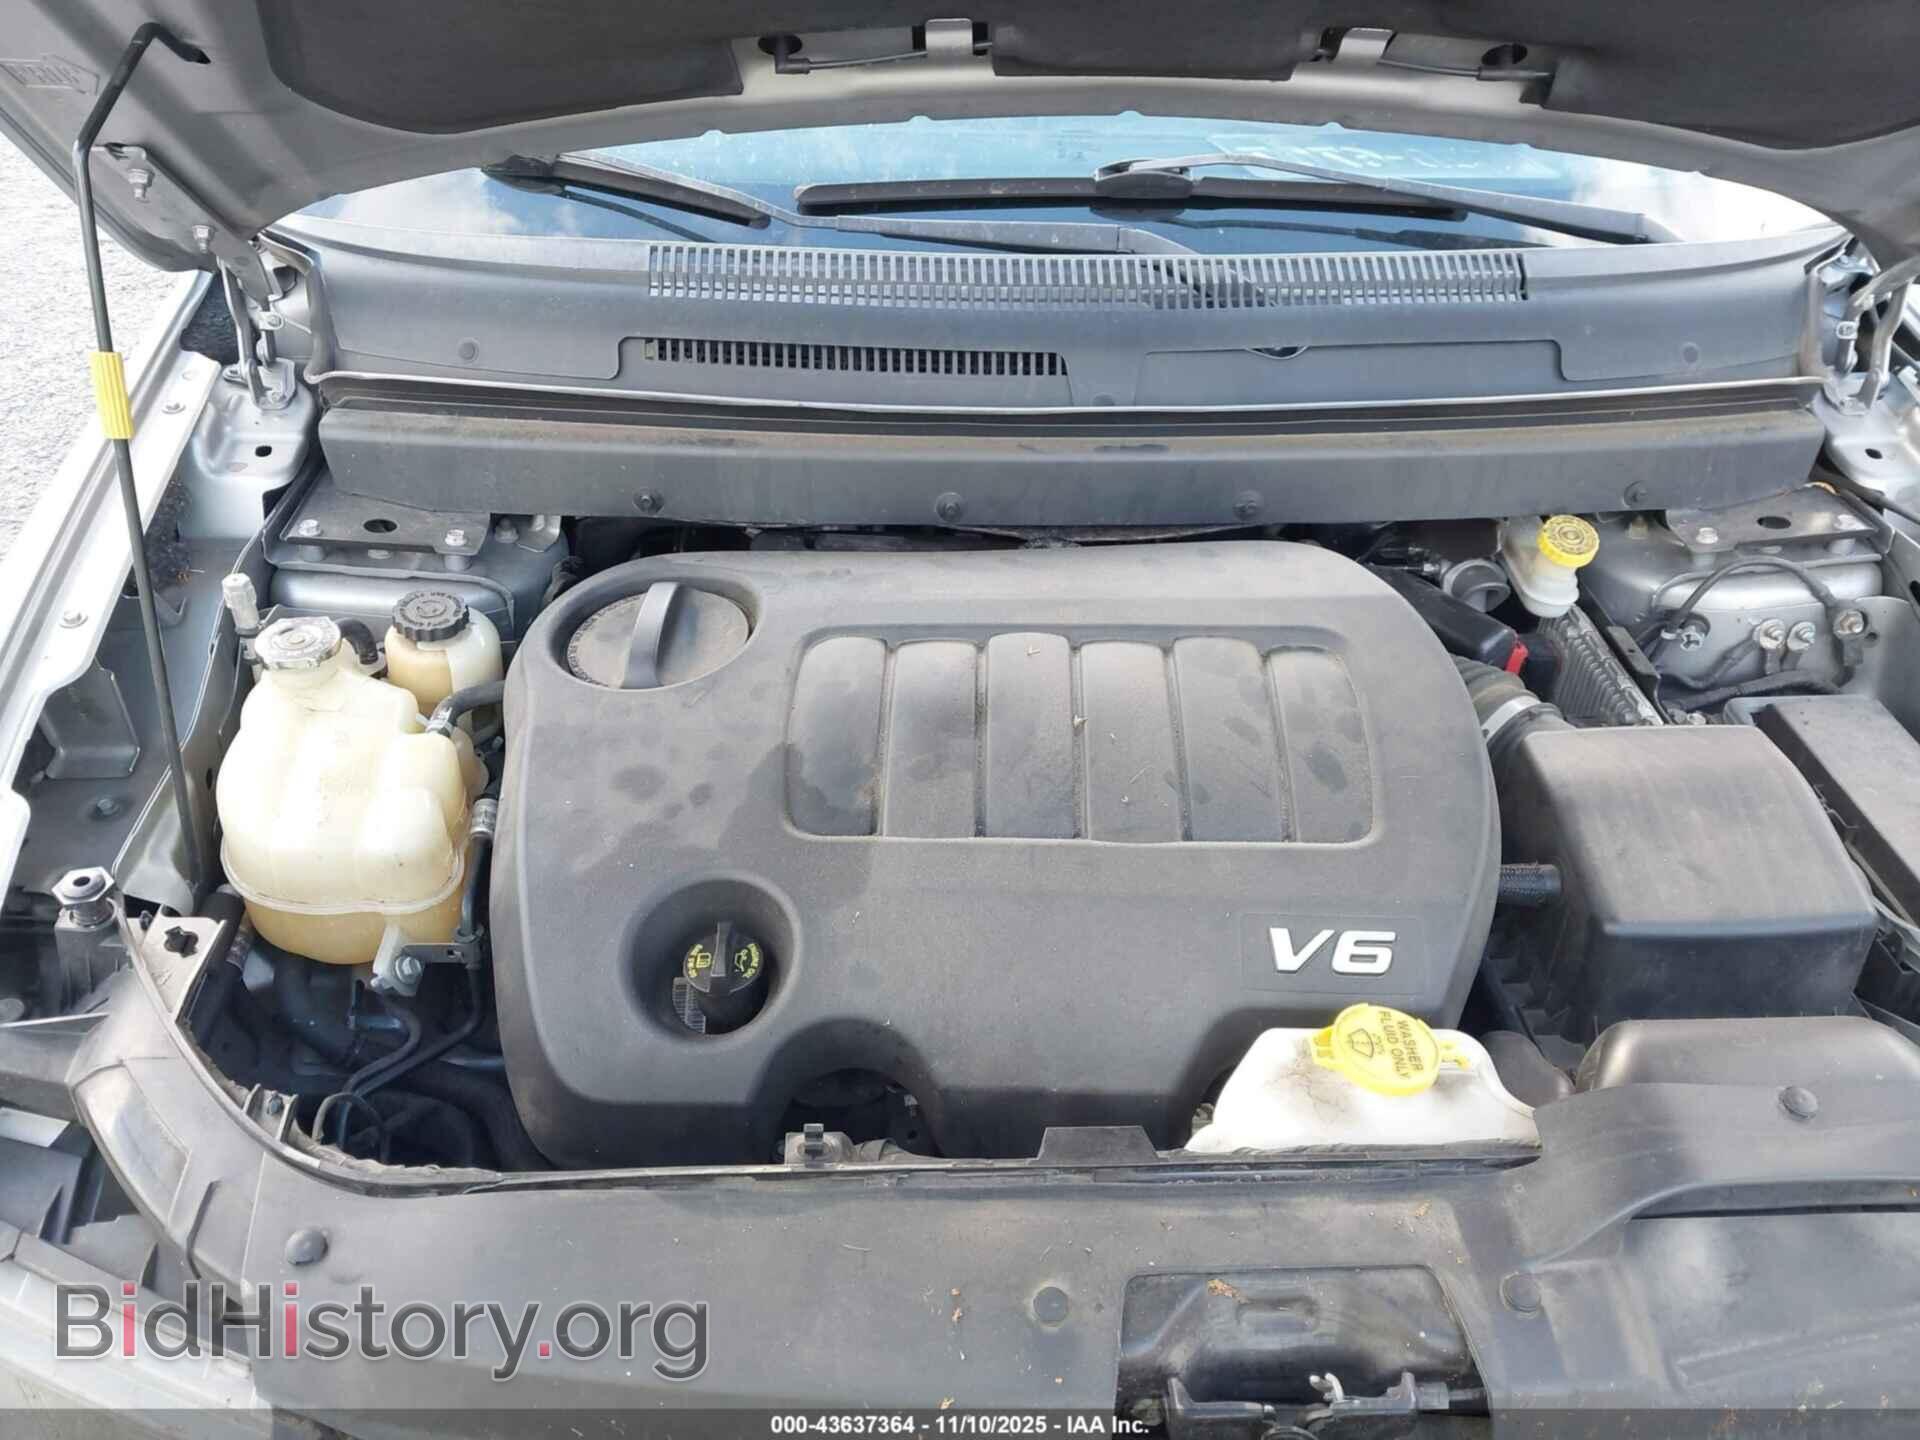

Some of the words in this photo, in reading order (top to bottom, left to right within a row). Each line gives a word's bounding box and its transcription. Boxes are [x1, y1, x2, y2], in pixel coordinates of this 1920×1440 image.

[1269, 927, 1397, 975] V6
[1378, 1010, 1400, 1045] FLUID
[1391, 1048, 1412, 1080] ONLY
[1397, 1019, 1424, 1072] WASHER
